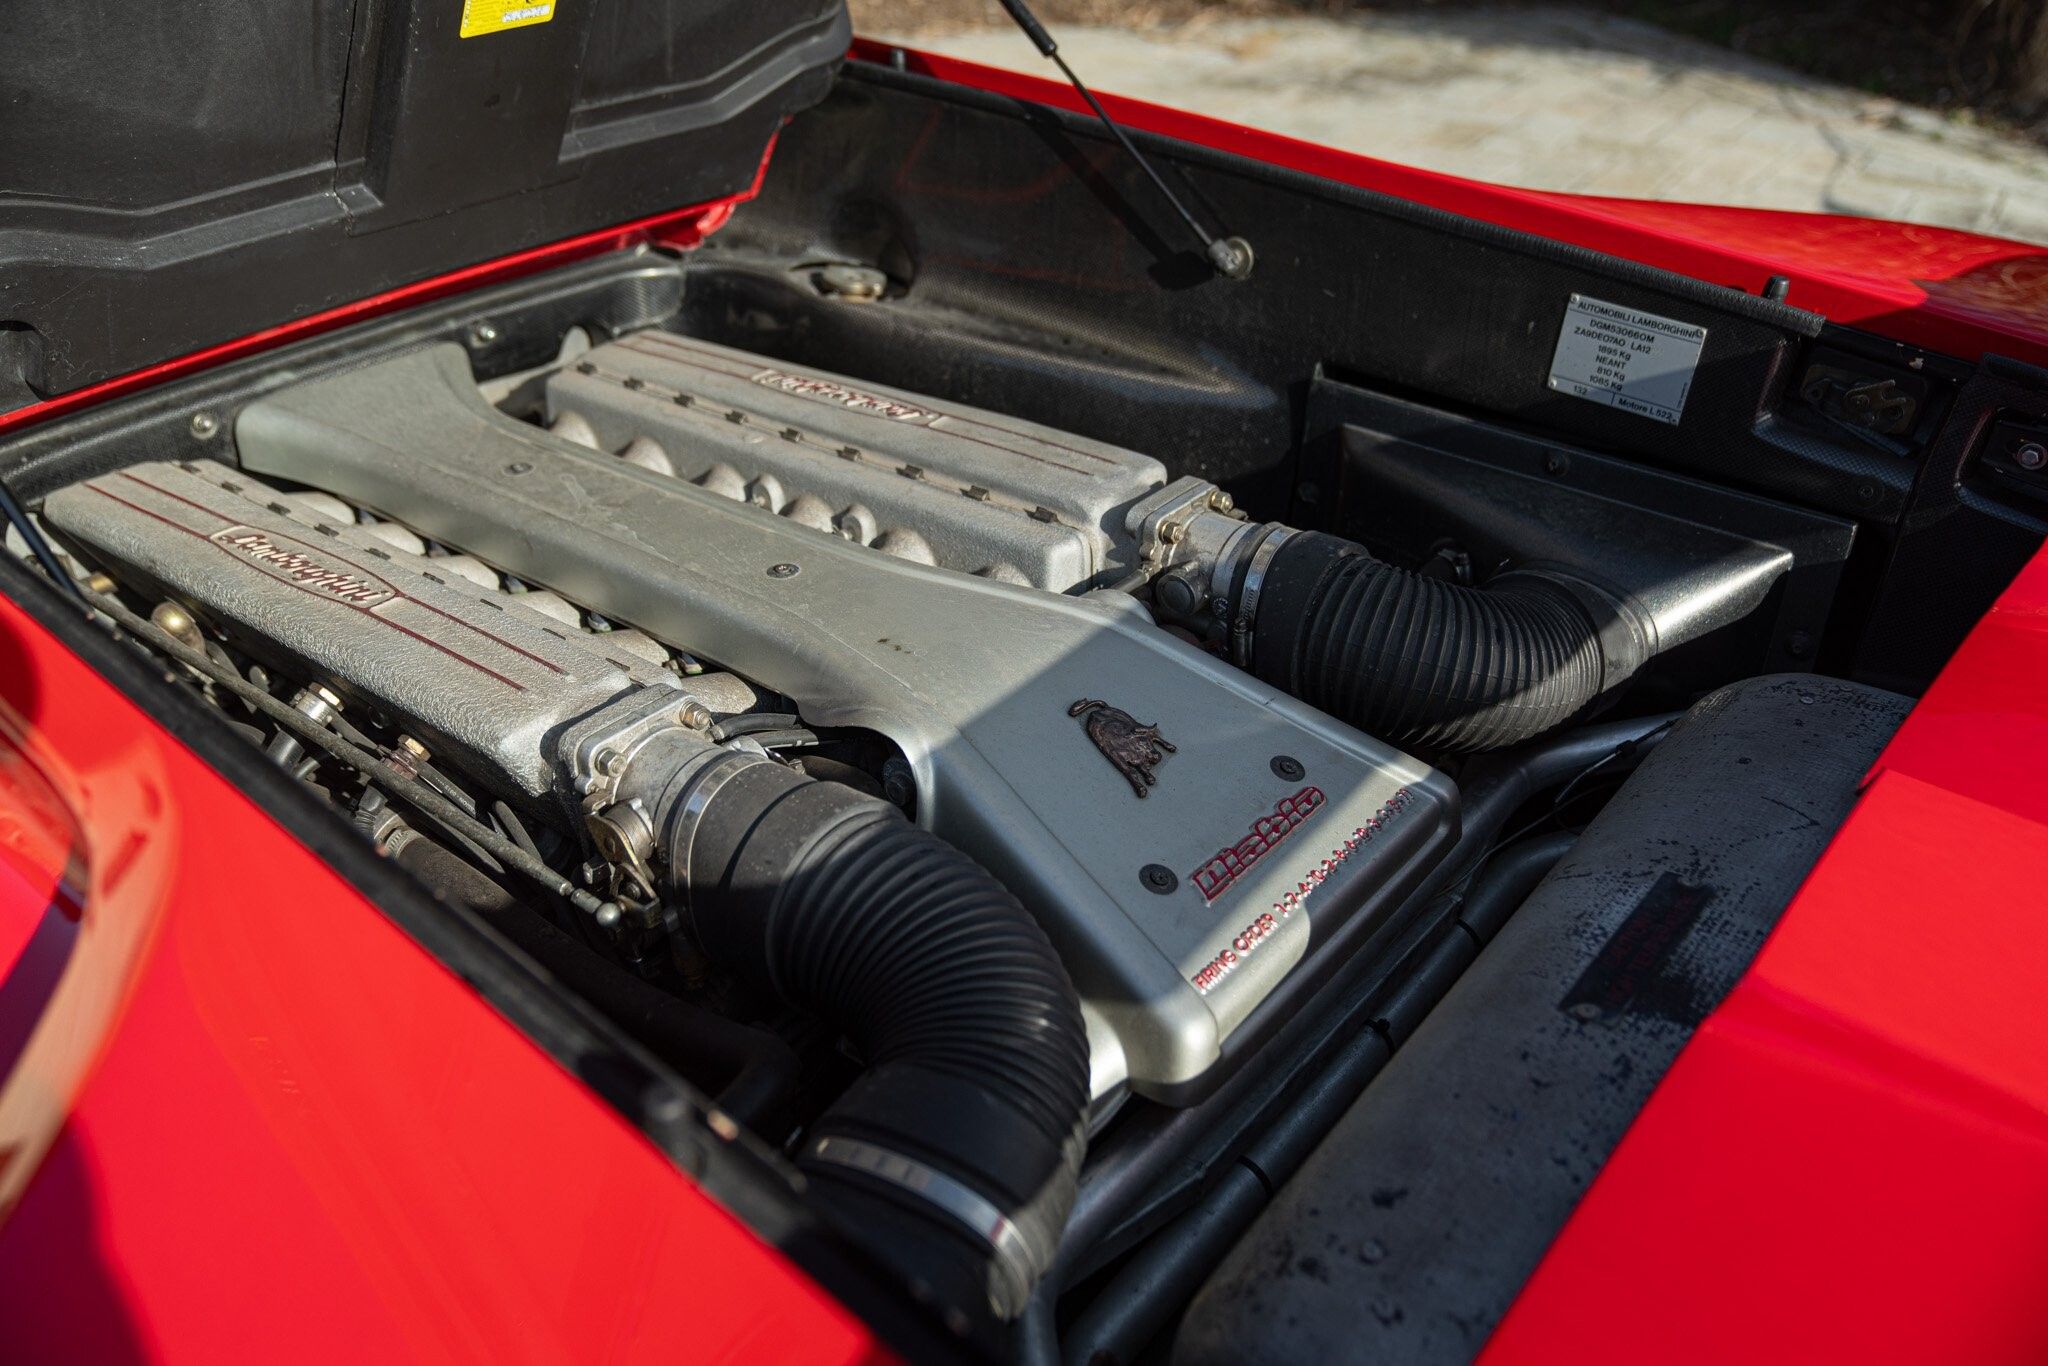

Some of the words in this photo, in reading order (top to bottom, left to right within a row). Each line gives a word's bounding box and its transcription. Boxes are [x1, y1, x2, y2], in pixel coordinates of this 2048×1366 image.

[1578, 302, 1630, 321] AUTOMOBILI
[1632, 314, 1696, 338] LAMBORGHINI
[1631, 340, 1651, 354] LA12
[1595, 355, 1626, 369] NEANT
[1619, 350, 1631, 361] Kg
[1597, 366, 1612, 377] 810
[1614, 370, 1626, 381] Kg
[1611, 380, 1623, 392] Kg
[1618, 398, 1648, 413] Motore
[218, 534, 391, 604] Lamborghini
[1192, 786, 1327, 903] Diablo
[1192, 949, 1237, 993] FIRING
[1233, 913, 1277, 955] ORDER
